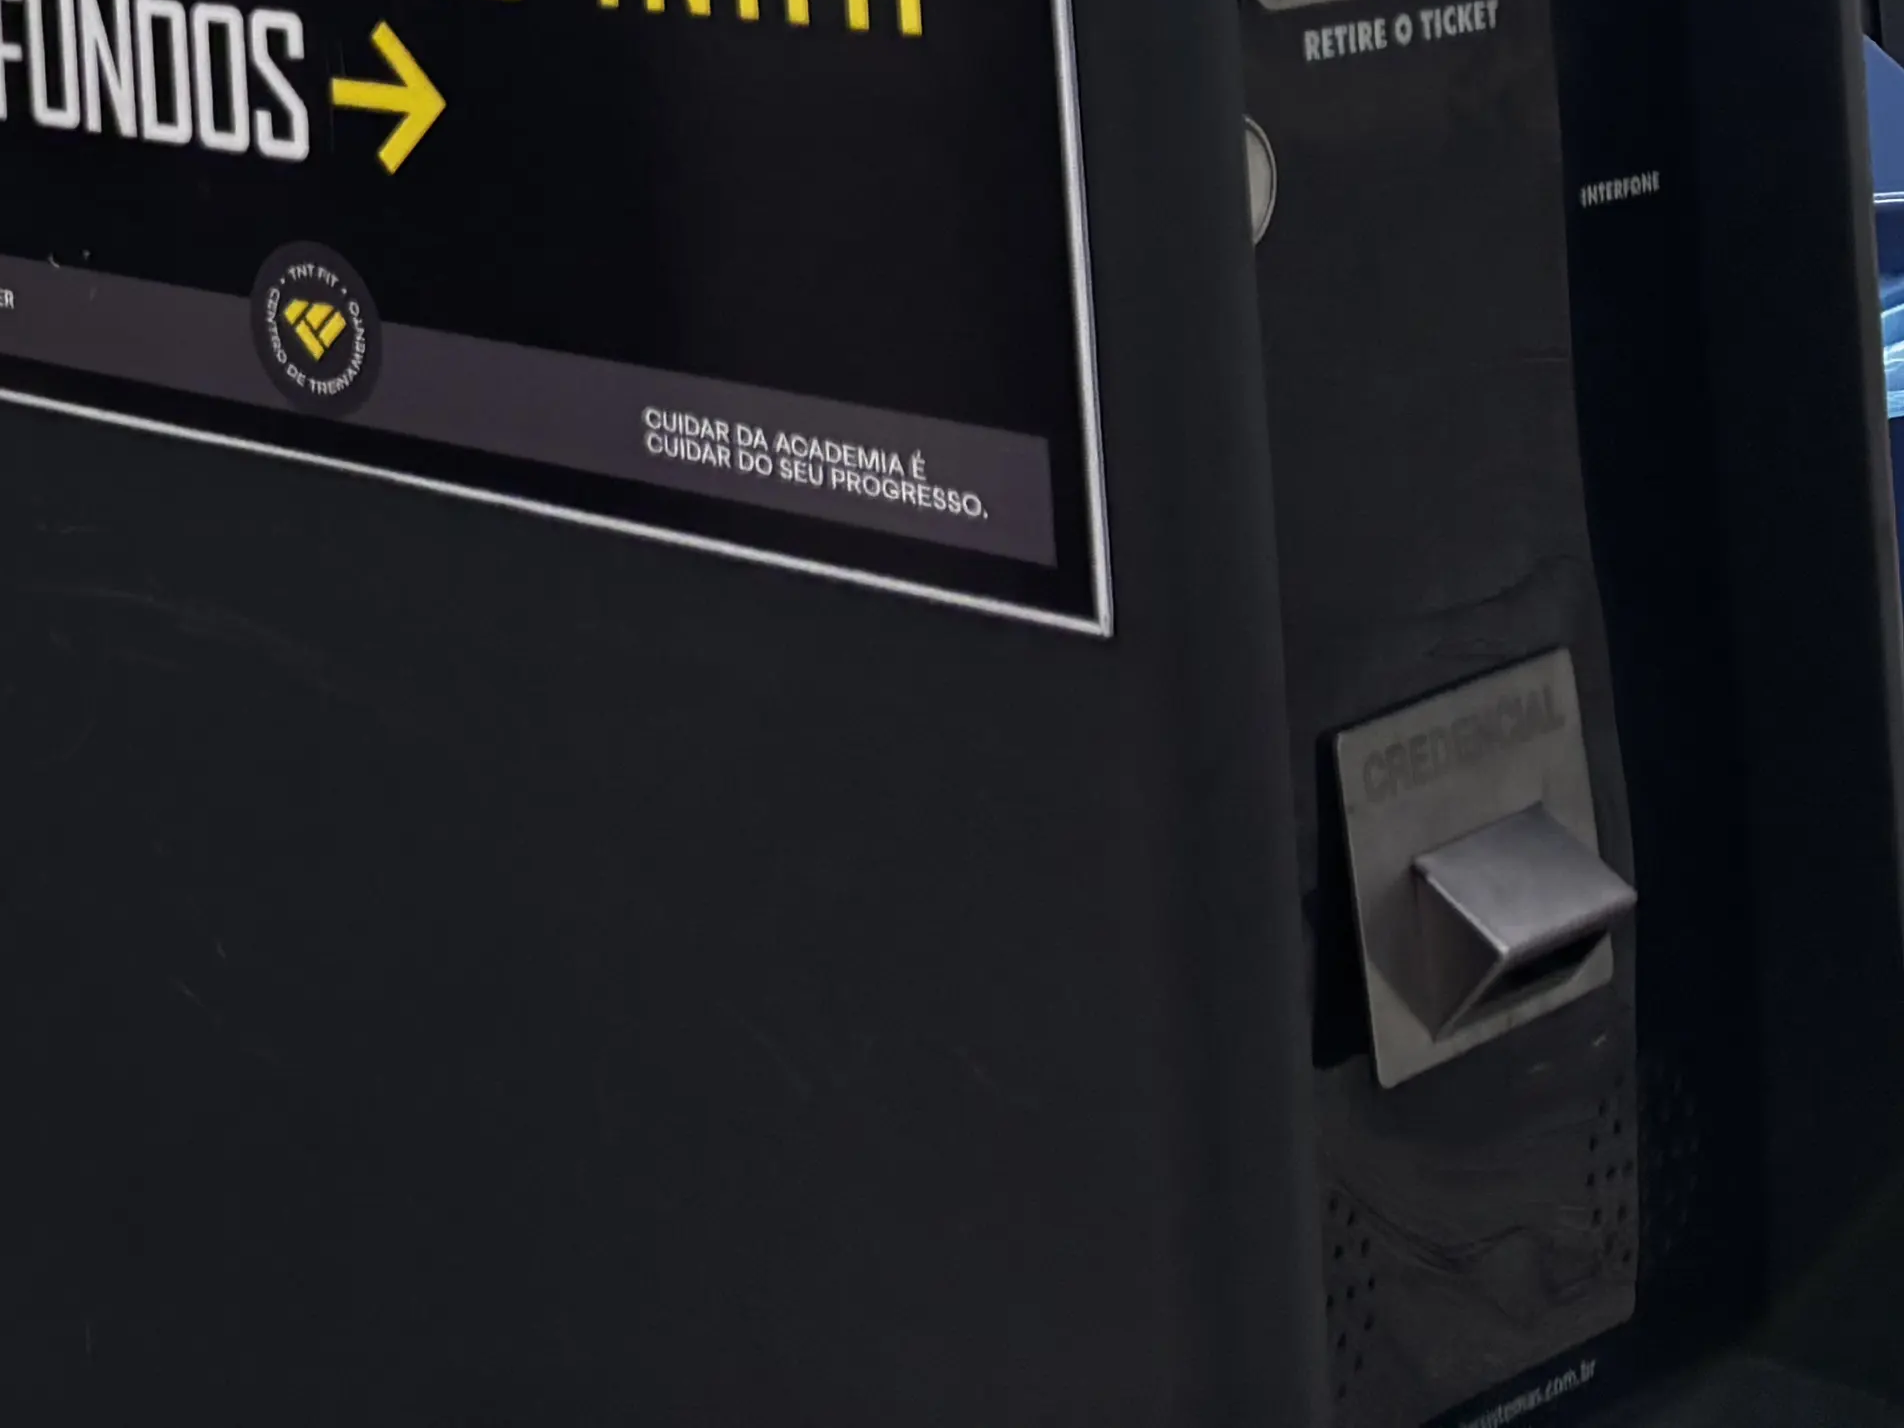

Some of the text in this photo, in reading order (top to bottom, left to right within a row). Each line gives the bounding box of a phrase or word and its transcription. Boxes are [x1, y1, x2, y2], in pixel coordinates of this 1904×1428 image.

[1304, 18, 1388, 62] RETIRE
[1394, 12, 1413, 46] O
[1580, 170, 1660, 209] INTERFONE
[287, 263, 340, 288] TNT FIT
[265, 287, 366, 395] CENTRO DE TREINAMENTO
[642, 406, 927, 482] CUIDAR DA ACADEMIA É
[645, 433, 989, 519] CUIDAR DO SEU PROGRESSO.
